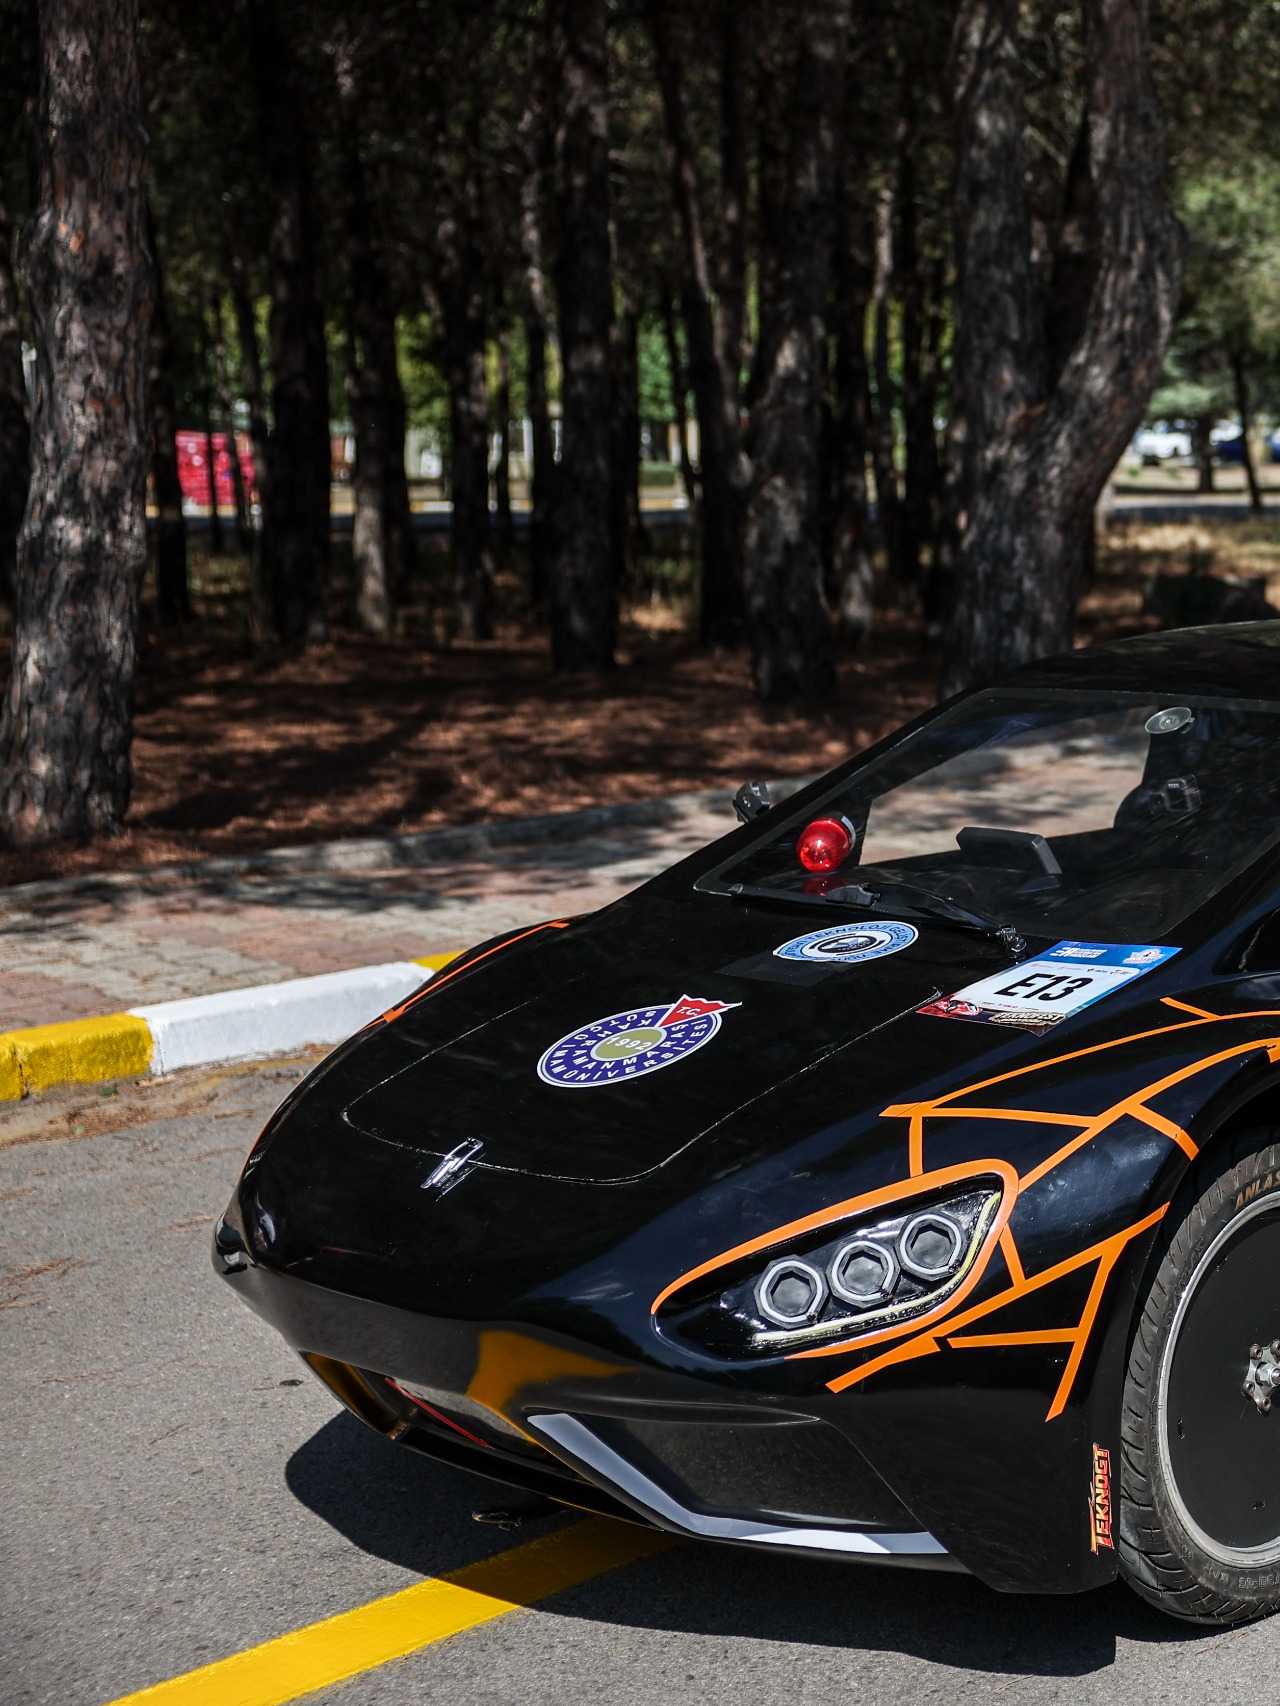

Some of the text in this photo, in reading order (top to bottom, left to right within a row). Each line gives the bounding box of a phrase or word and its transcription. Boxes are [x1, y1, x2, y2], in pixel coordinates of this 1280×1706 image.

[993, 973, 1094, 1001] E13
[676, 1006, 701, 1016] T.C.
[606, 1036, 653, 1051] 1992
[1090, 1443, 1113, 1554] TEKNOGT
